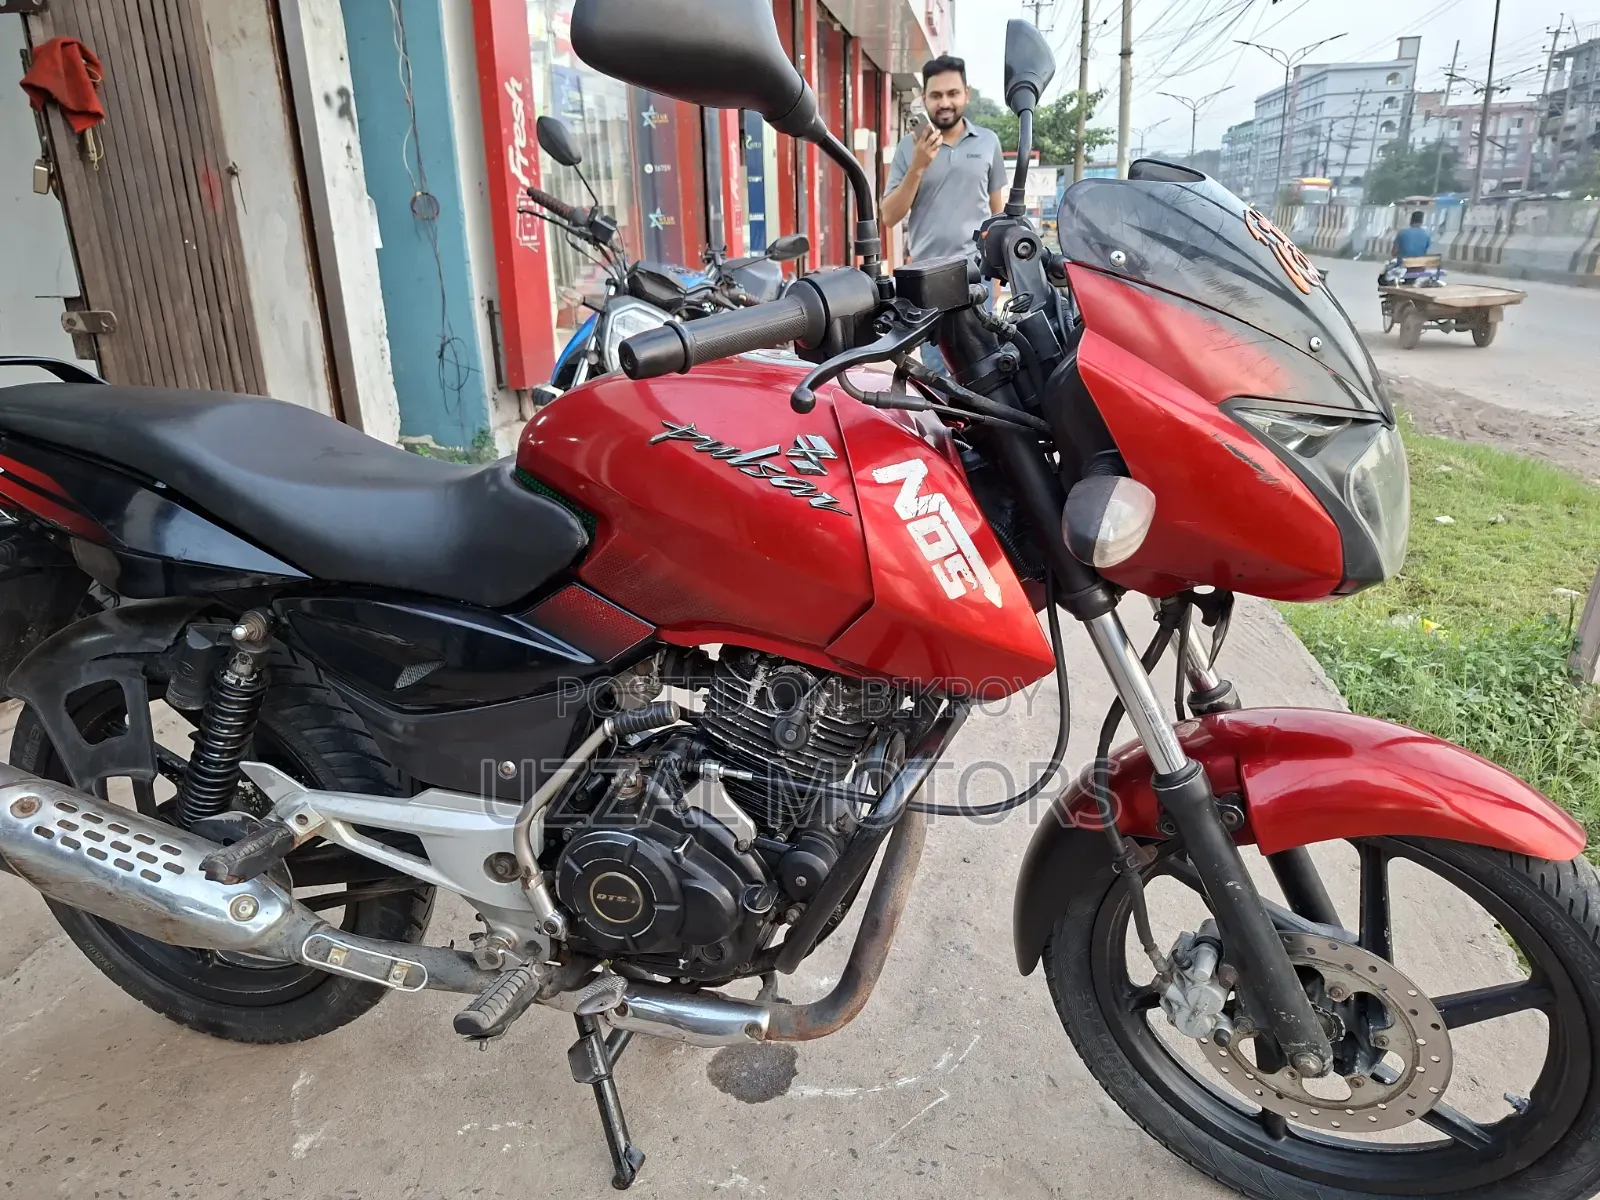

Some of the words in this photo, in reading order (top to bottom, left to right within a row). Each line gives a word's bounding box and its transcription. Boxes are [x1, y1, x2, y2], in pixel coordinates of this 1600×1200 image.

[504, 76, 531, 187] Fresh
[647, 420, 852, 516] Pulsar
[872, 458, 1002, 608] NOS
